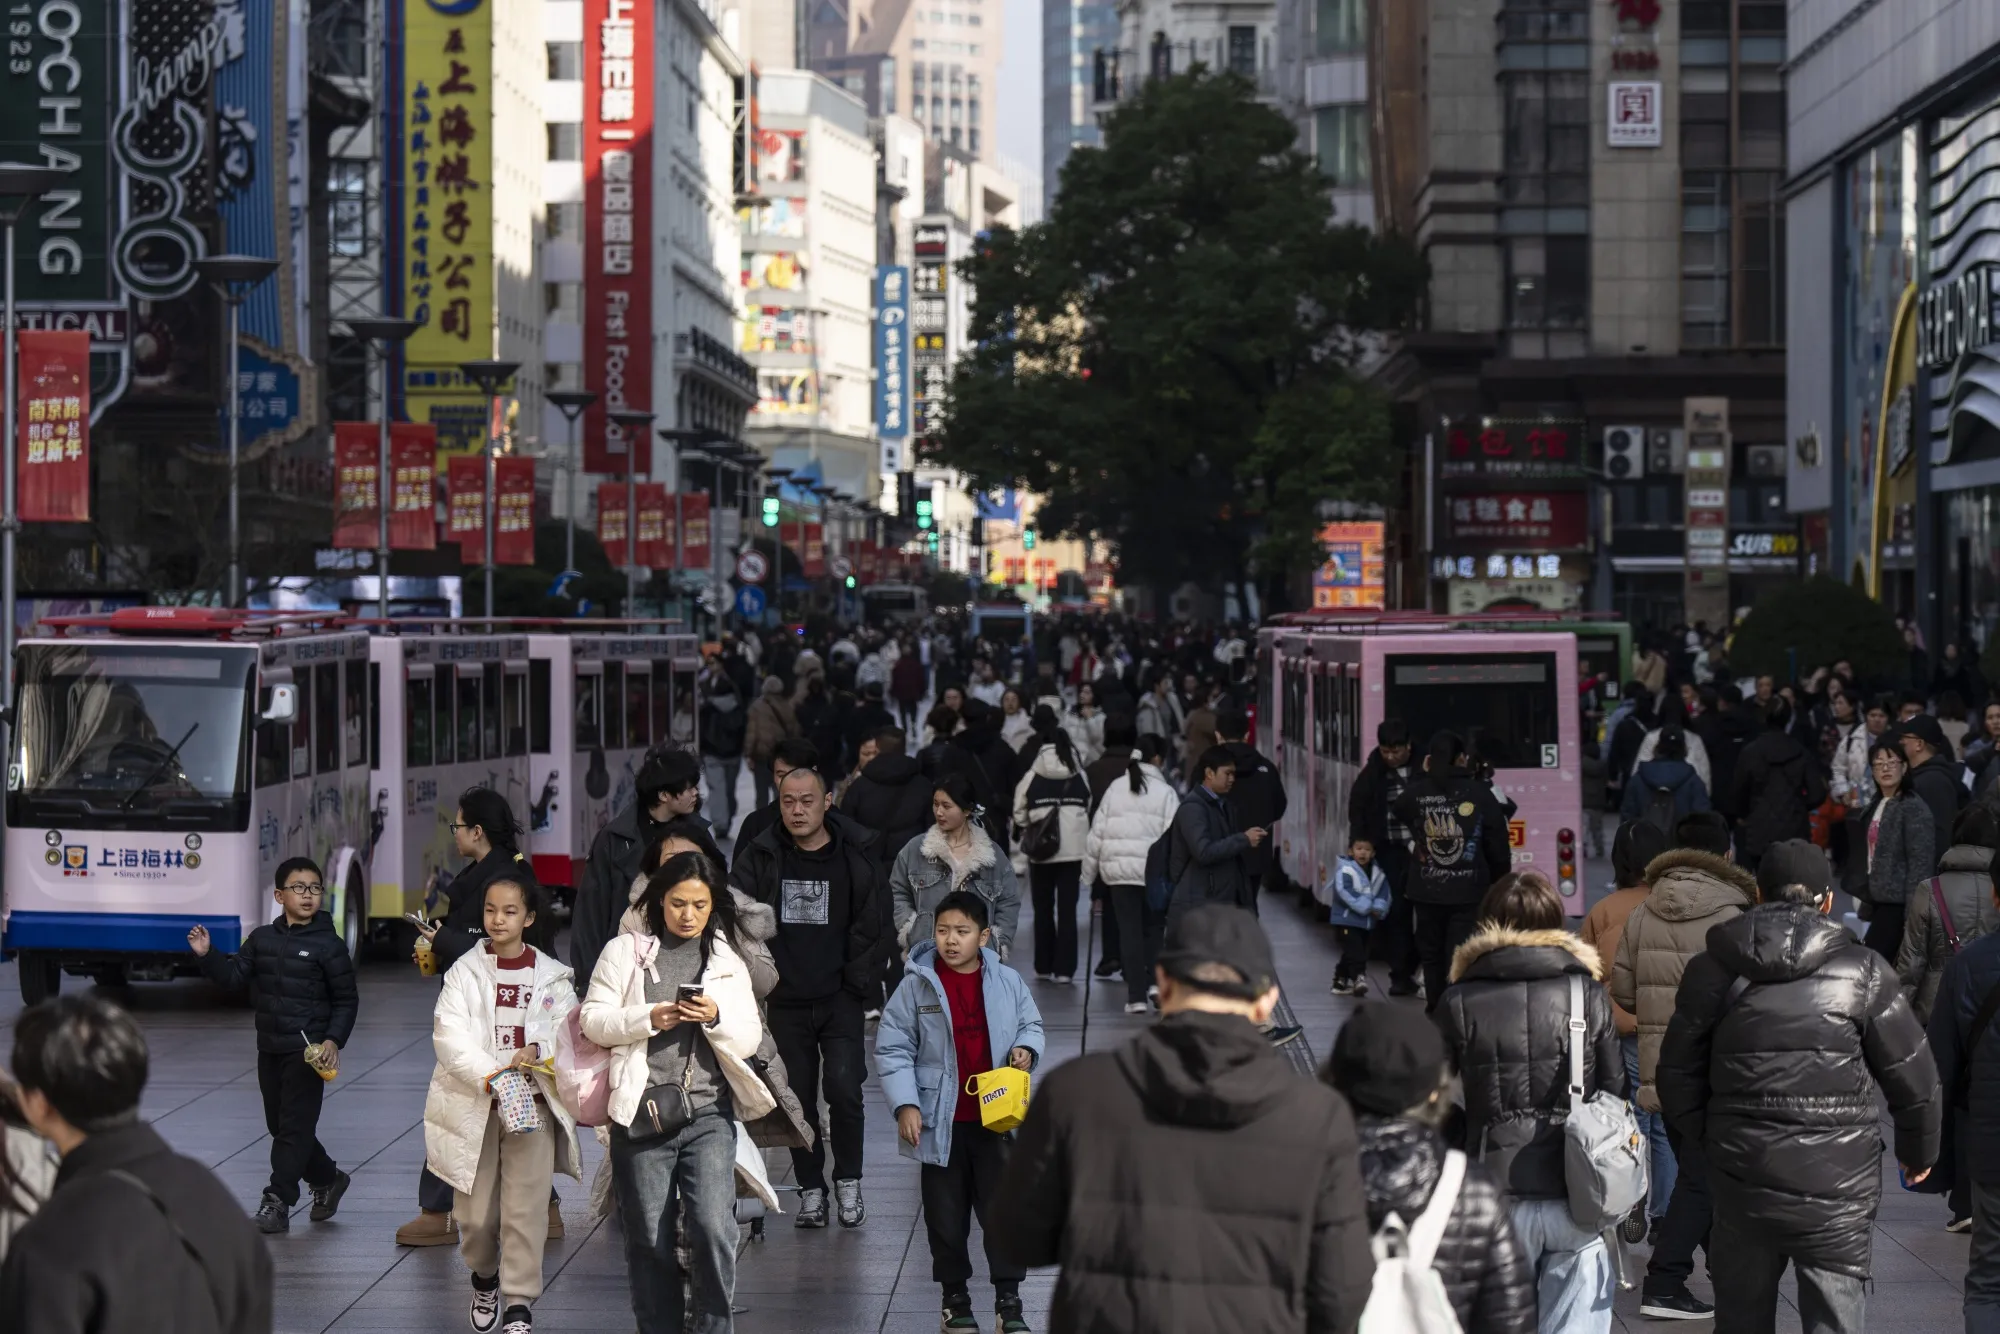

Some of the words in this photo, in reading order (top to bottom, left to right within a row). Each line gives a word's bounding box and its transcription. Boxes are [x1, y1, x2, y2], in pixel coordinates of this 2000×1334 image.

[9, 3, 32, 75] 1923
[601, 0, 634, 275] 上海市第一食品商店
[606, 291, 629, 338] First
[1916, 266, 1990, 368] SEPHORA
[227, 371, 277, 393] 罗蒙
[606, 345, 629, 414] Food
[28, 396, 80, 422] 南京路
[606, 417, 628, 454] all
[27, 438, 82, 464] 迎新年
[1544, 746, 1556, 767] 5
[9, 766, 18, 788] 9
[97, 847, 184, 868] 上海梅林
[119, 870, 140, 879] Since
[143, 871, 161, 880] 1930
